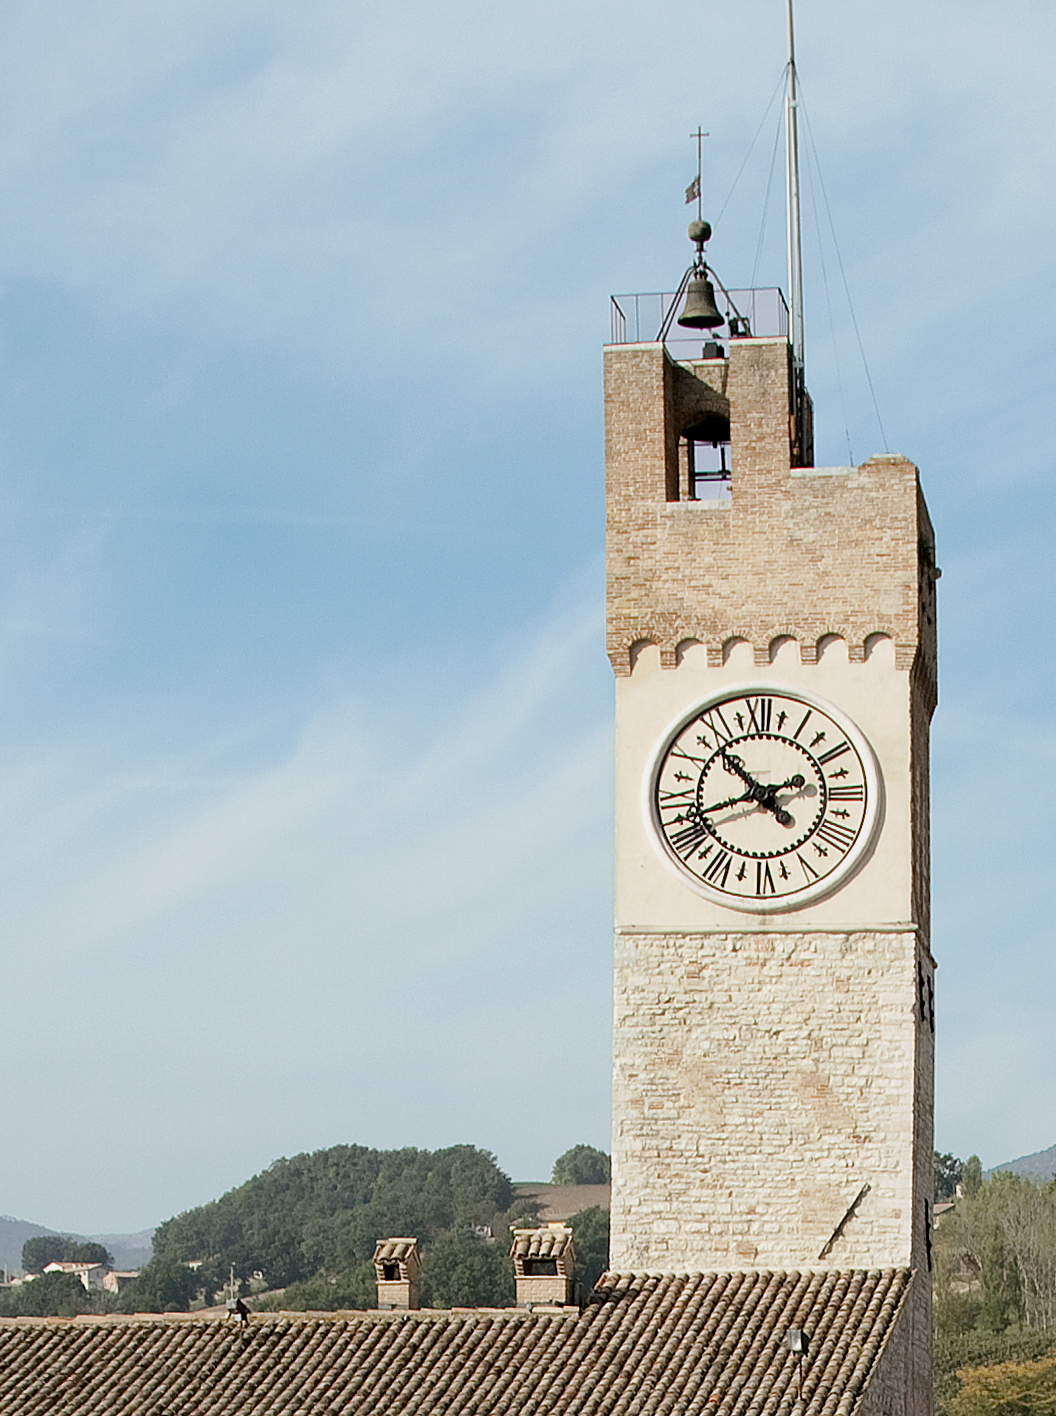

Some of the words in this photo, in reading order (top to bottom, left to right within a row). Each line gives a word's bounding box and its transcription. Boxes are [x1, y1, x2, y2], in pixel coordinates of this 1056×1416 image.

[745, 698, 773, 735] XII
[792, 709, 813, 740] I
[817, 740, 852, 766] II
[828, 785, 864, 801] III
